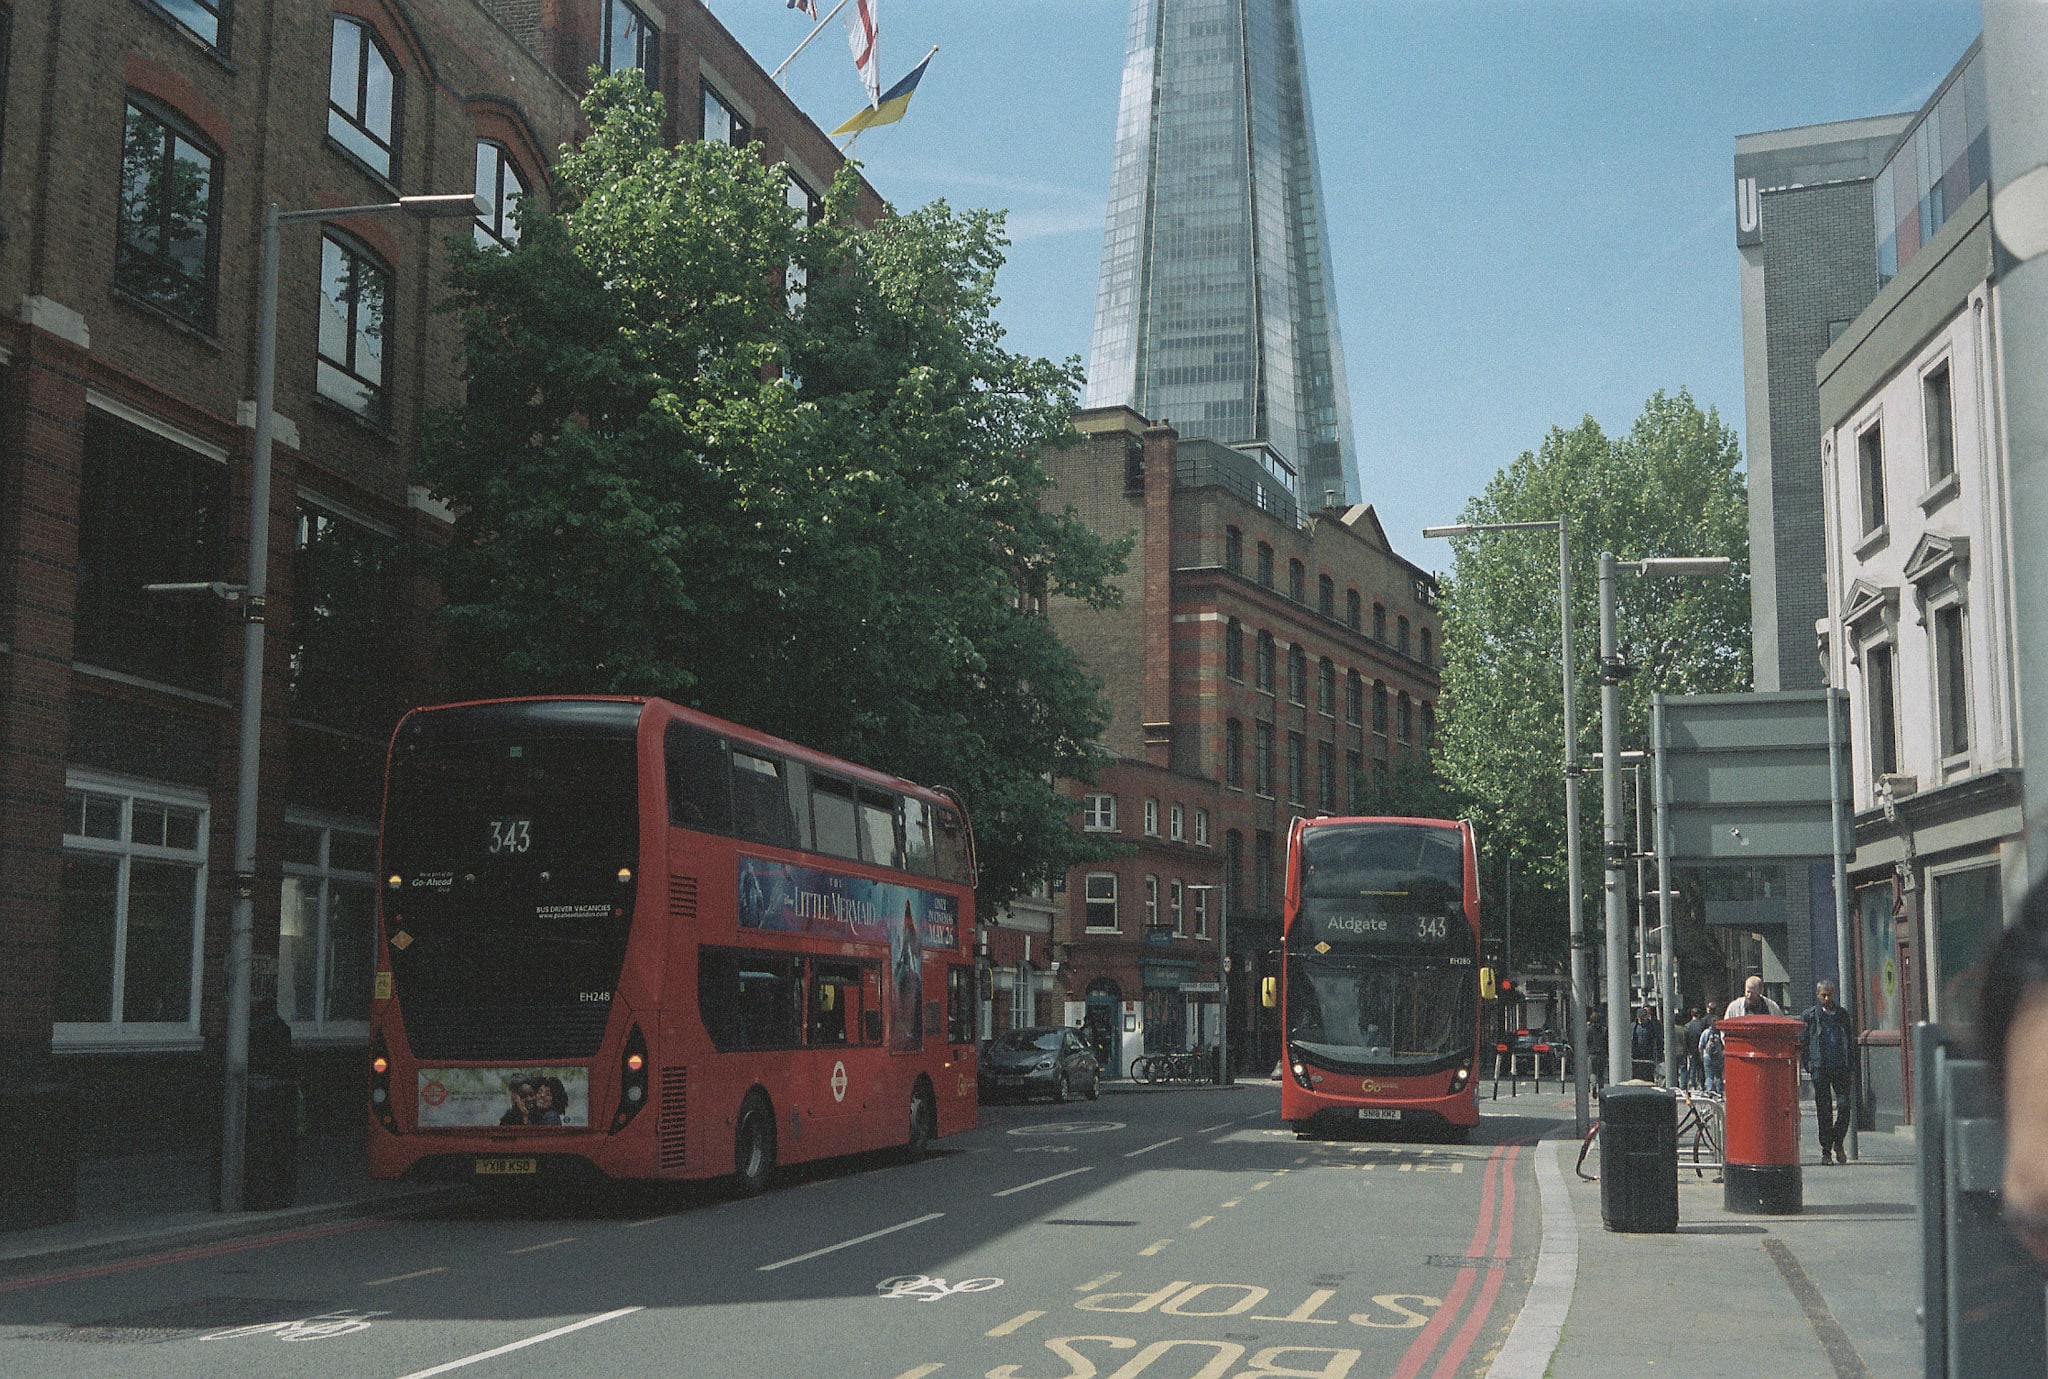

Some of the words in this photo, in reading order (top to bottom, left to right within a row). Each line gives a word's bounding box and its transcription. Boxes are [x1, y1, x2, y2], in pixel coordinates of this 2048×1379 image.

[489, 820, 531, 853] 343
[411, 878, 453, 887] Go-Ahead
[550, 905, 573, 913] DRIVER
[574, 904, 611, 912] VACANCIES
[795, 886, 830, 921] LITTLE
[831, 892, 877, 936] MERMAID
[1328, 916, 1388, 933] Aldgate
[1417, 916, 1446, 938] 343
[579, 992, 611, 1002] EH248
[1074, 1281, 1441, 1329] STOP
